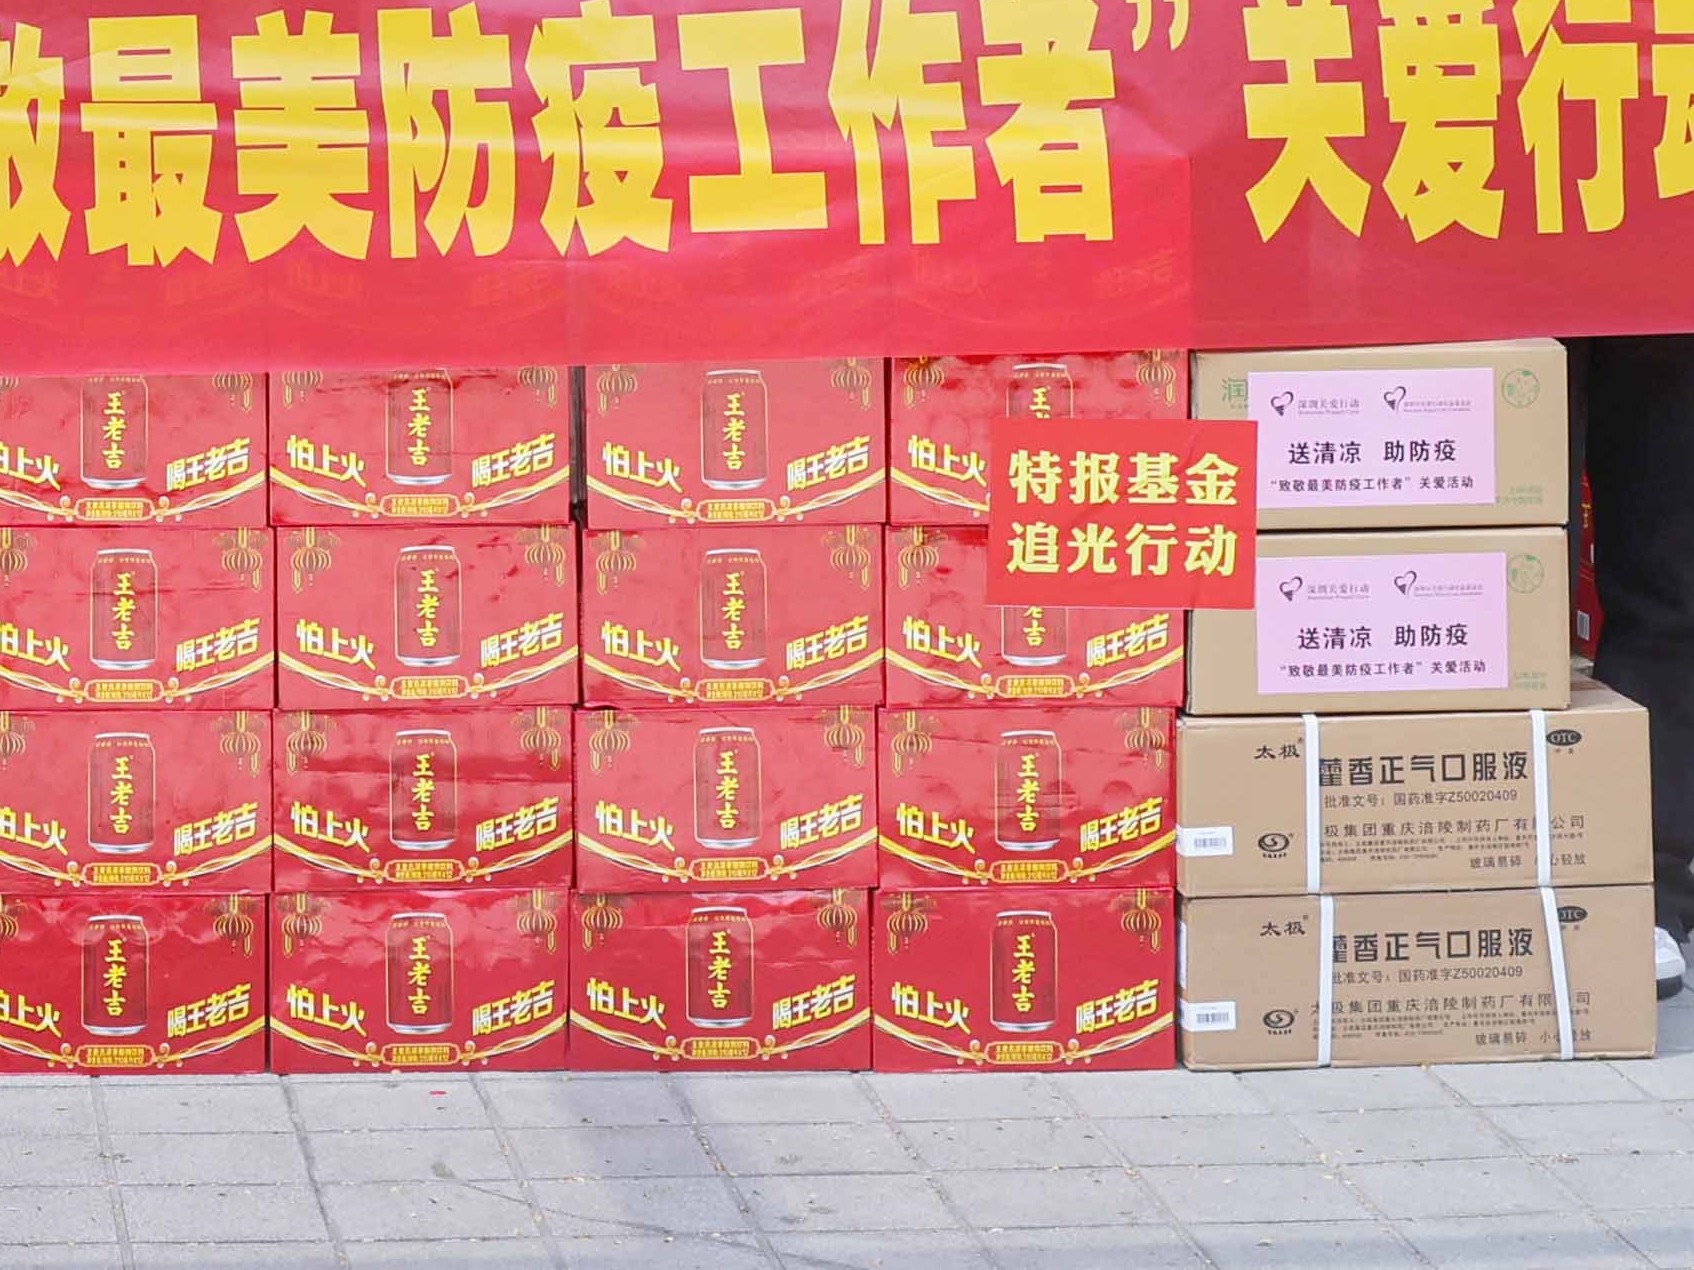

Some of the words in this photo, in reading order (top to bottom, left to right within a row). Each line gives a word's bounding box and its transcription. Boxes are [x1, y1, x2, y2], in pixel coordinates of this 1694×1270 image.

[102, 391, 127, 470] 王老吉
[722, 392, 747, 471] 王老吉
[1288, 442, 1362, 465] 送清凉
[1383, 439, 1456, 463] 助防疫
[166, 436, 250, 492] 喝王老吉
[603, 440, 682, 492] 怕上火
[786, 435, 870, 491] 喝王老吉
[1008, 449, 1240, 506] 特报基金
[1419, 475, 1474, 490] 关爱活动
[1006, 521, 1238, 577] 追光行动
[416, 569, 441, 648] 王老吉
[1297, 625, 1373, 650] 送清凉
[1394, 623, 1469, 648] 助防疫
[296, 617, 375, 669] 怕上火
[480, 612, 564, 668] 喝王老吉
[903, 615, 982, 667] 怕上火
[1086, 612, 1170, 668] 喝王老吉
[1430, 659, 1486, 675] 关爱活动
[110, 756, 135, 835] 王老吉
[716, 751, 741, 830] 王老吉
[174, 801, 258, 857] 喝王老吉
[596, 799, 675, 851] 怕上火
[780, 793, 864, 849] 喝王老吉
[408, 936, 433, 1015] 王老吉
[1012, 934, 1037, 1013] 王老吉
[287, 983, 366, 1035] 怕上火
[472, 980, 556, 1036] 喝王老吉
[892, 981, 971, 1033] 怕上火
[1075, 978, 1159, 1034] 喝王老吉
